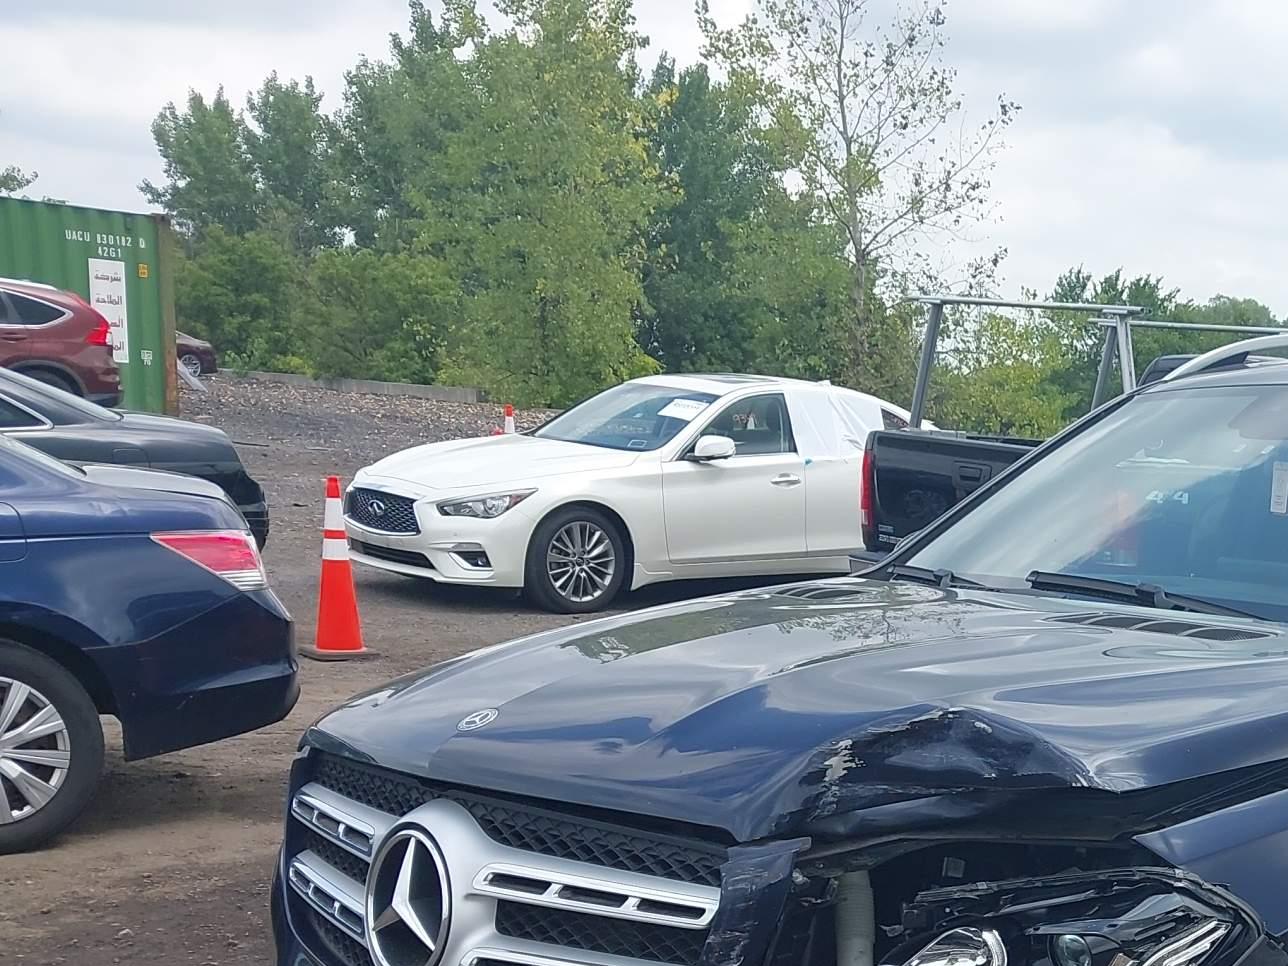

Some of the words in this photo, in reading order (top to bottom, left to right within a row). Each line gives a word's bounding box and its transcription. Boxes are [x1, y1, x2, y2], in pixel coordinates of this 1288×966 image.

[65, 229, 91, 242] UACU
[96, 233, 132, 246] 830182
[97, 246, 121, 258] 42G1
